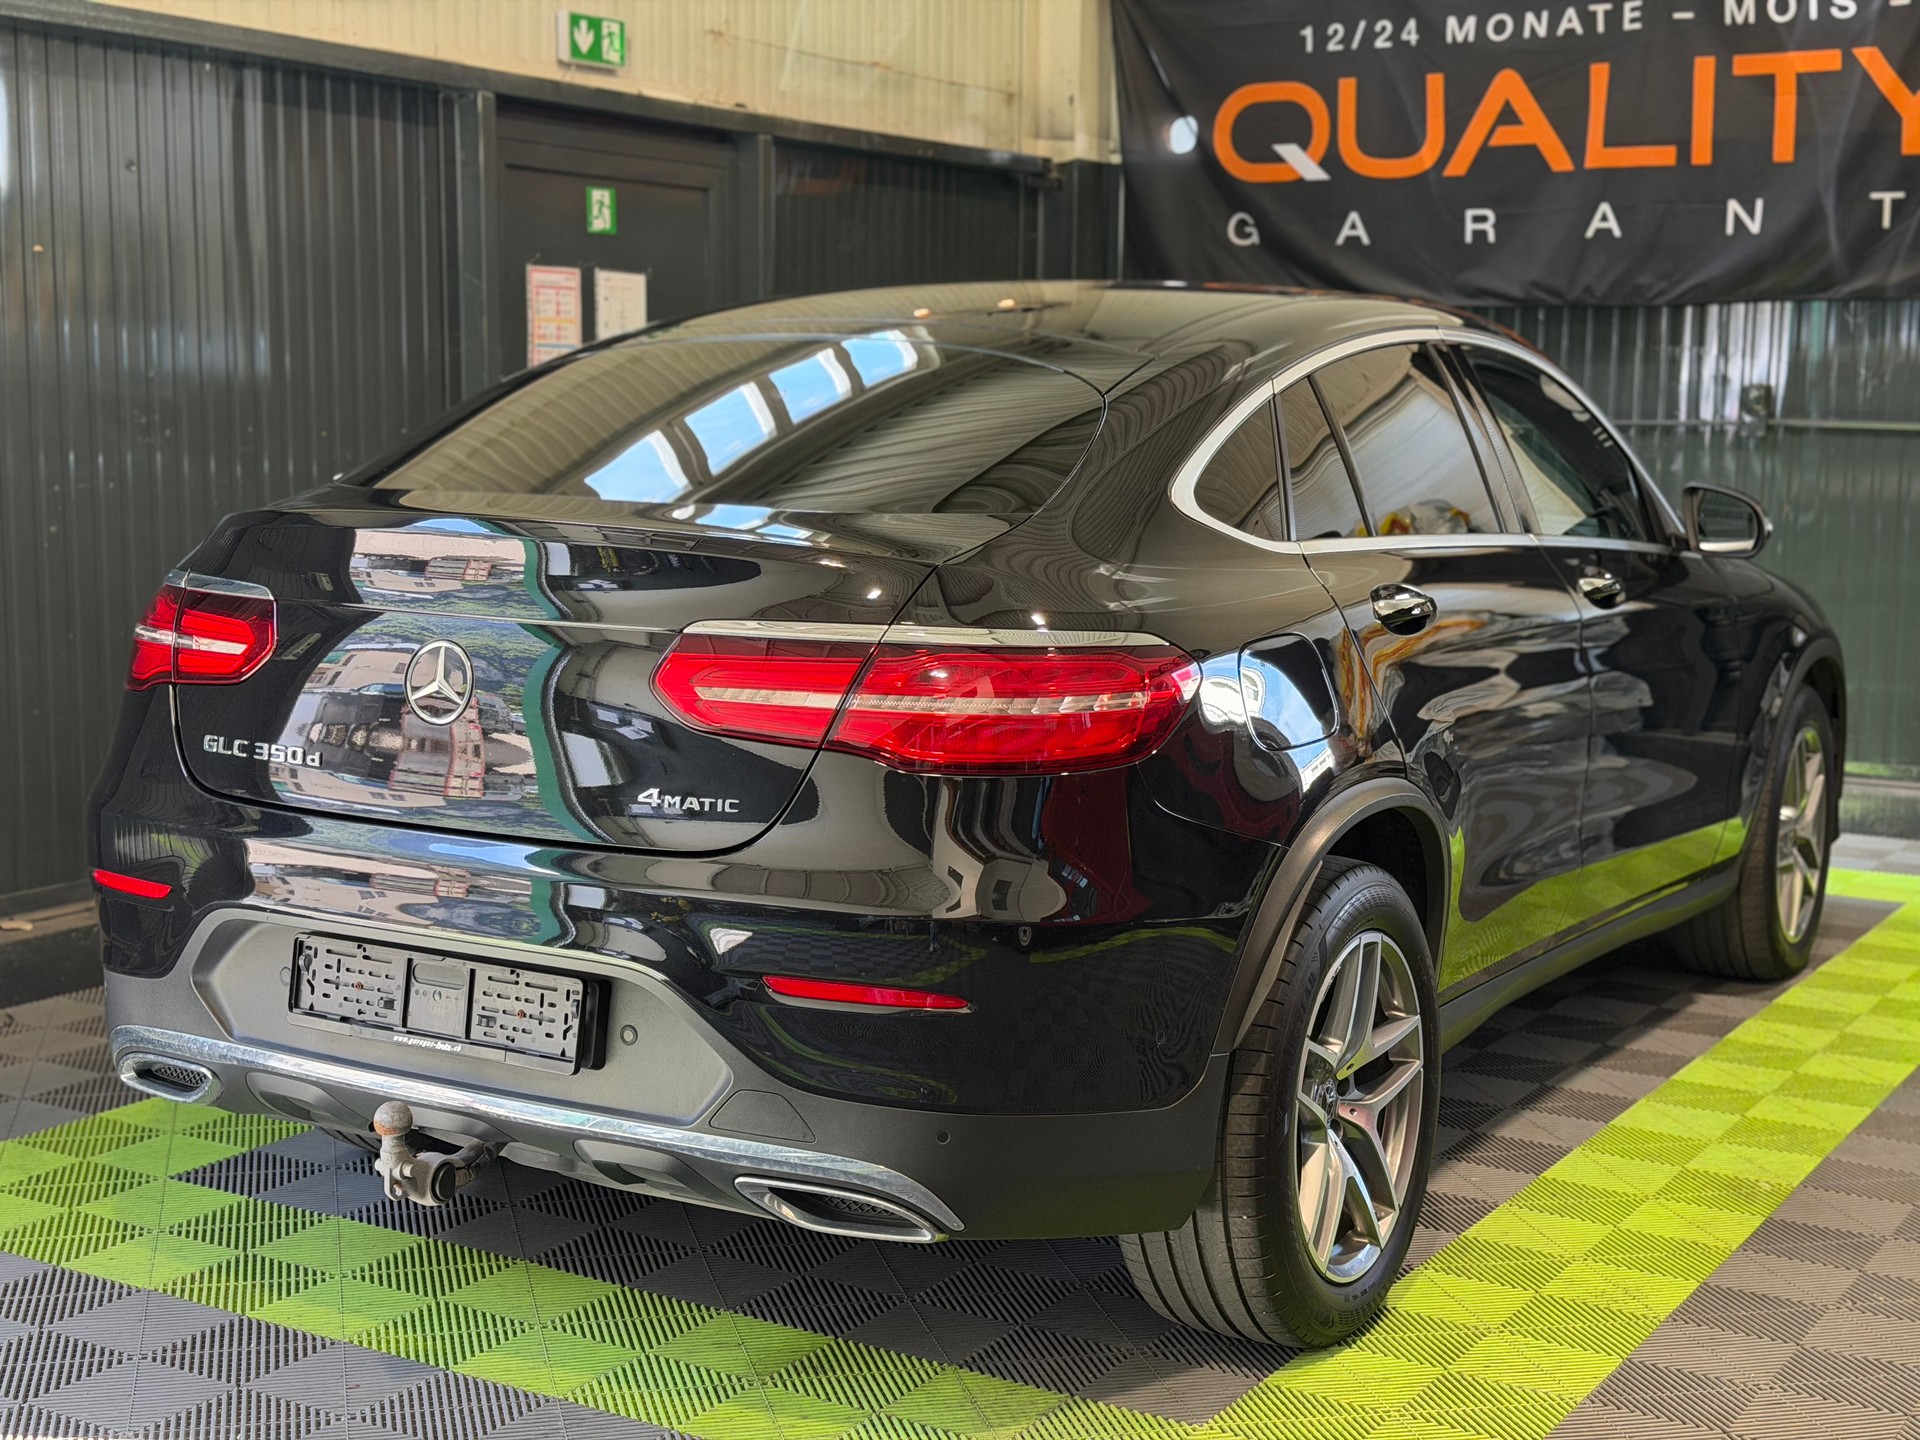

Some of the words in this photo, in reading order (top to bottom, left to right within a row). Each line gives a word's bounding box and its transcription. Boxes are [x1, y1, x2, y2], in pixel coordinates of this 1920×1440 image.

[1299, 17, 1420, 53] 12/24
[1445, 0, 1643, 44] MONATE
[1723, 0, 1858, 26] MOIS
[1212, 46, 1920, 183] QUALITY
[203, 734, 250, 758] GLC
[253, 742, 321, 767] 350d
[637, 787, 740, 812] 4MATIC
